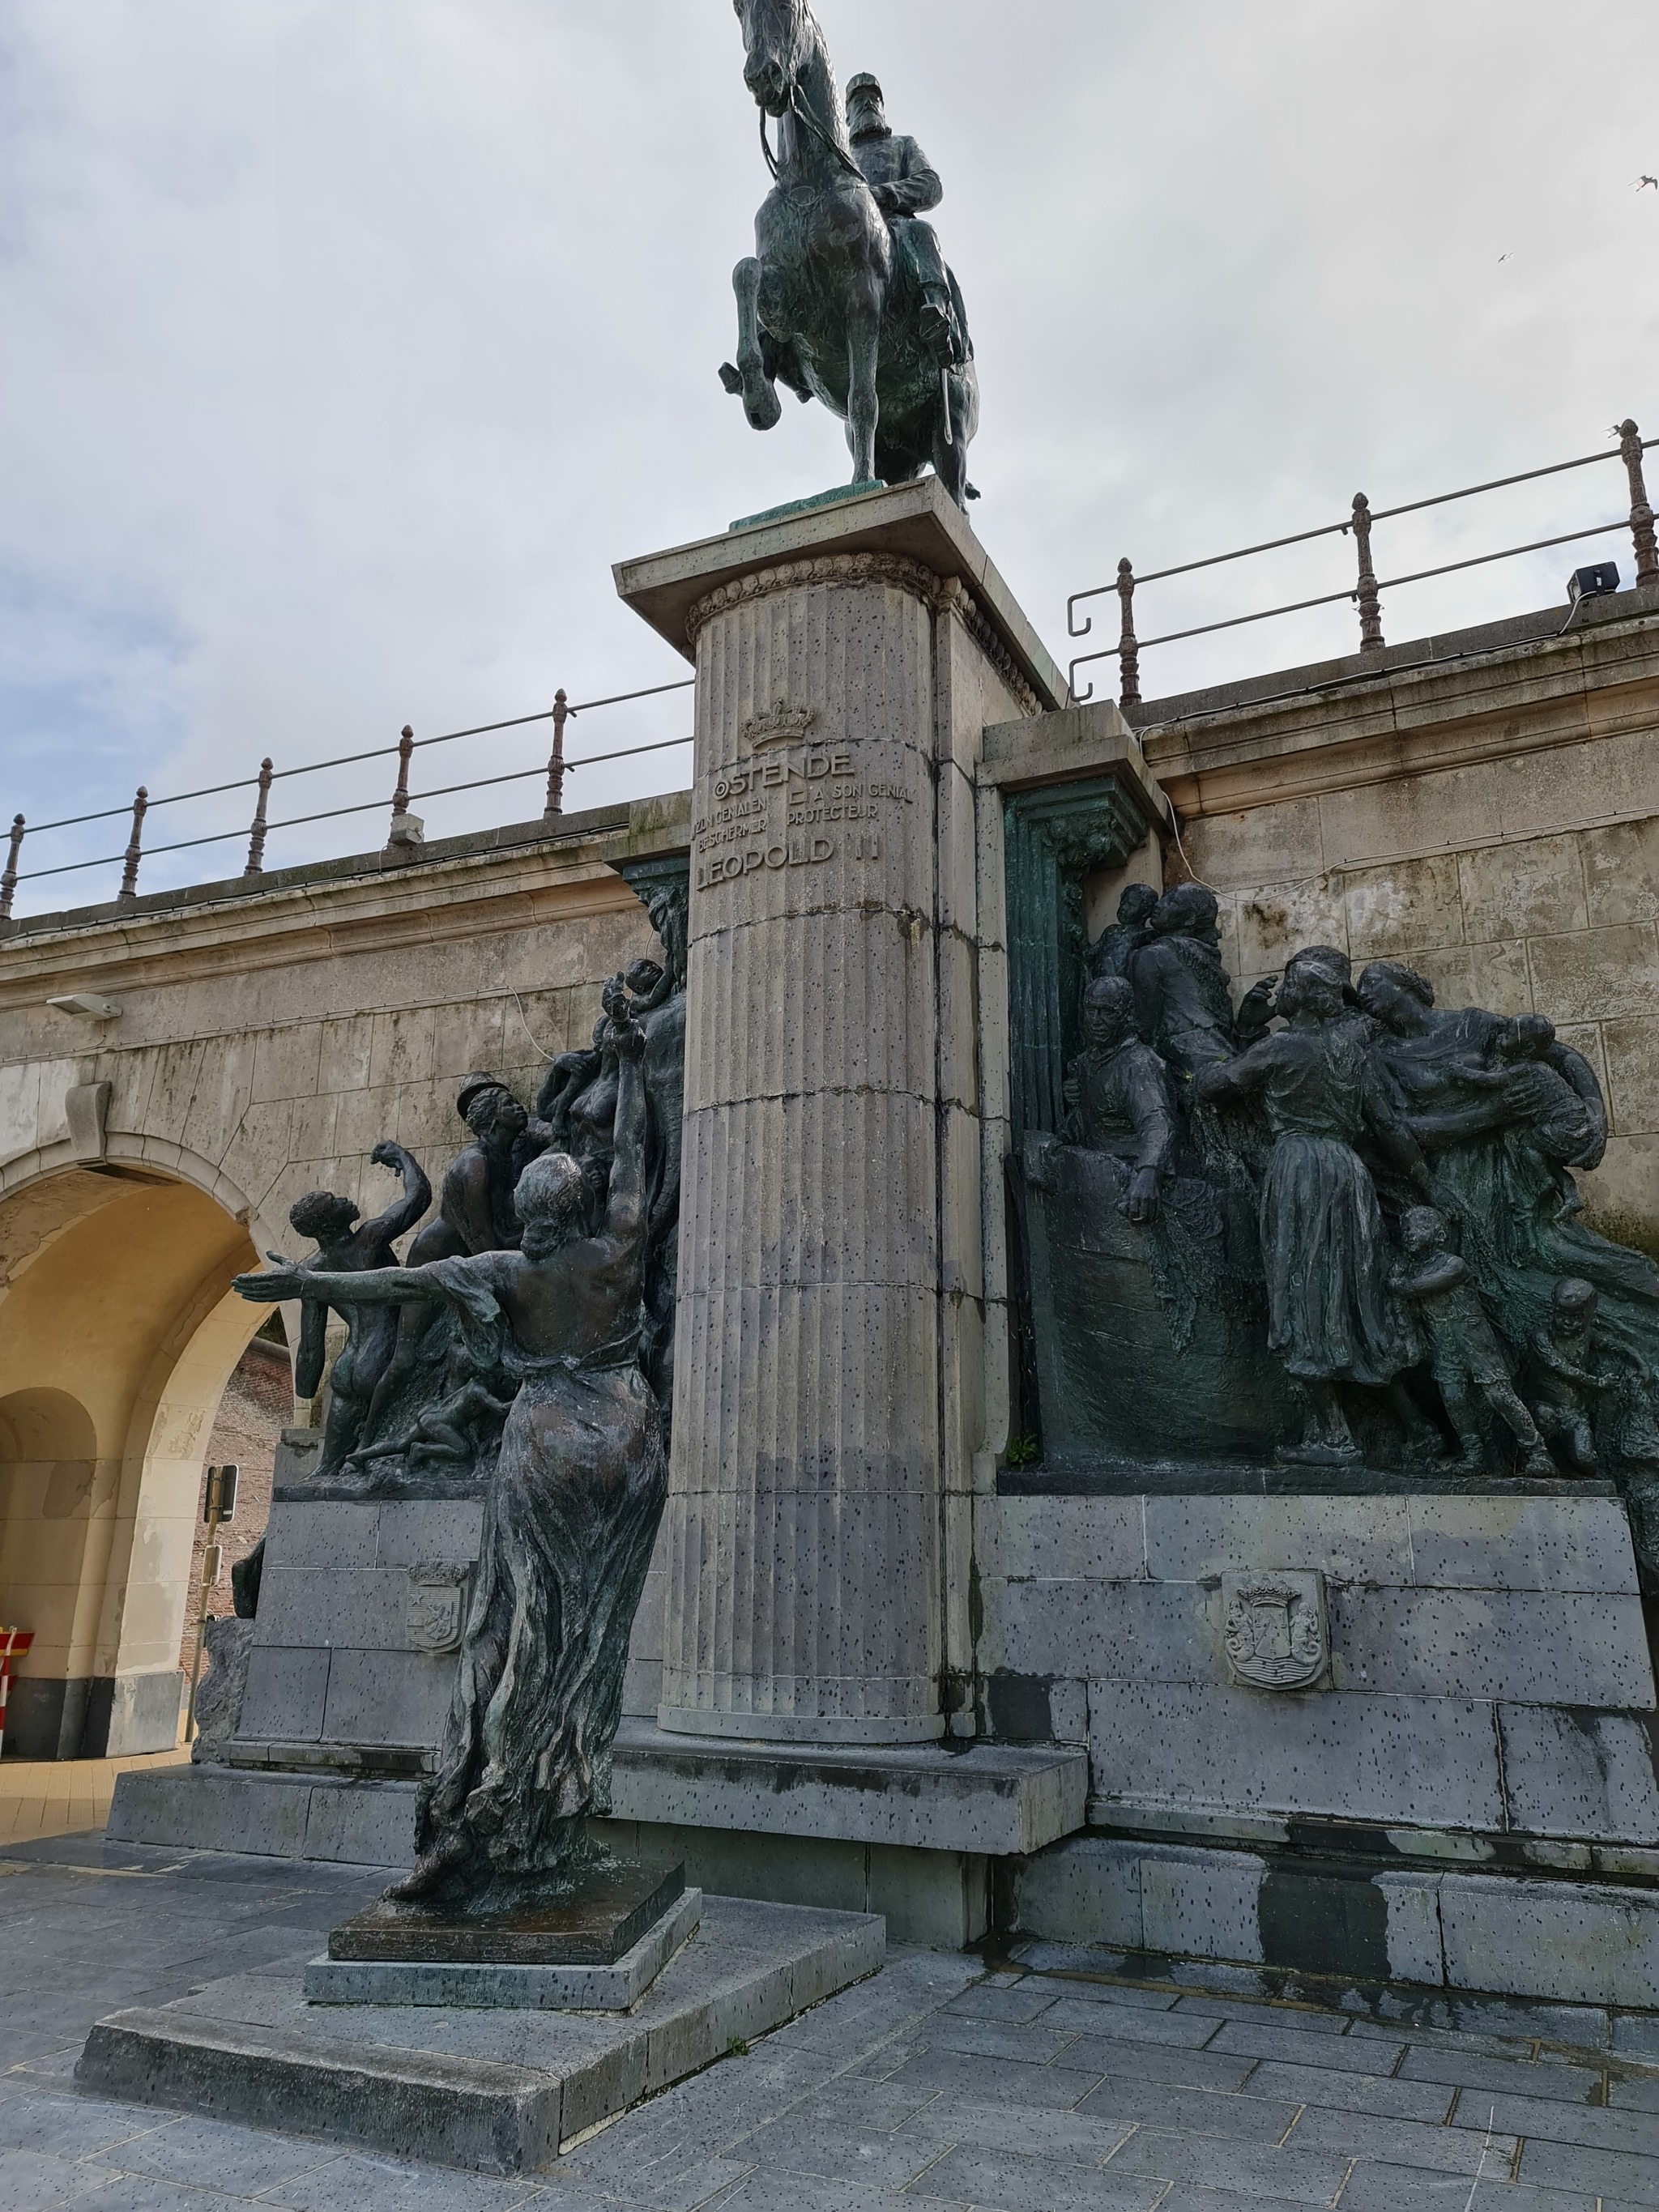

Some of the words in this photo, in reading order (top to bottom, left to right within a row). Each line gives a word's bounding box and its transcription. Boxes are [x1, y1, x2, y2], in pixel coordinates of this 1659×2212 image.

[714, 754, 855, 800] OSTENDE
[813, 787, 825, 802] A
[832, 784, 863, 799] SON
[868, 783, 913, 803] GENIAL
[716, 797, 766, 825] GENIALEN
[787, 804, 878, 826] PROTECTEUR
[699, 819, 767, 853] BESCHERMER
[697, 839, 834, 891] LEOPOLD
[855, 833, 879, 860] II
